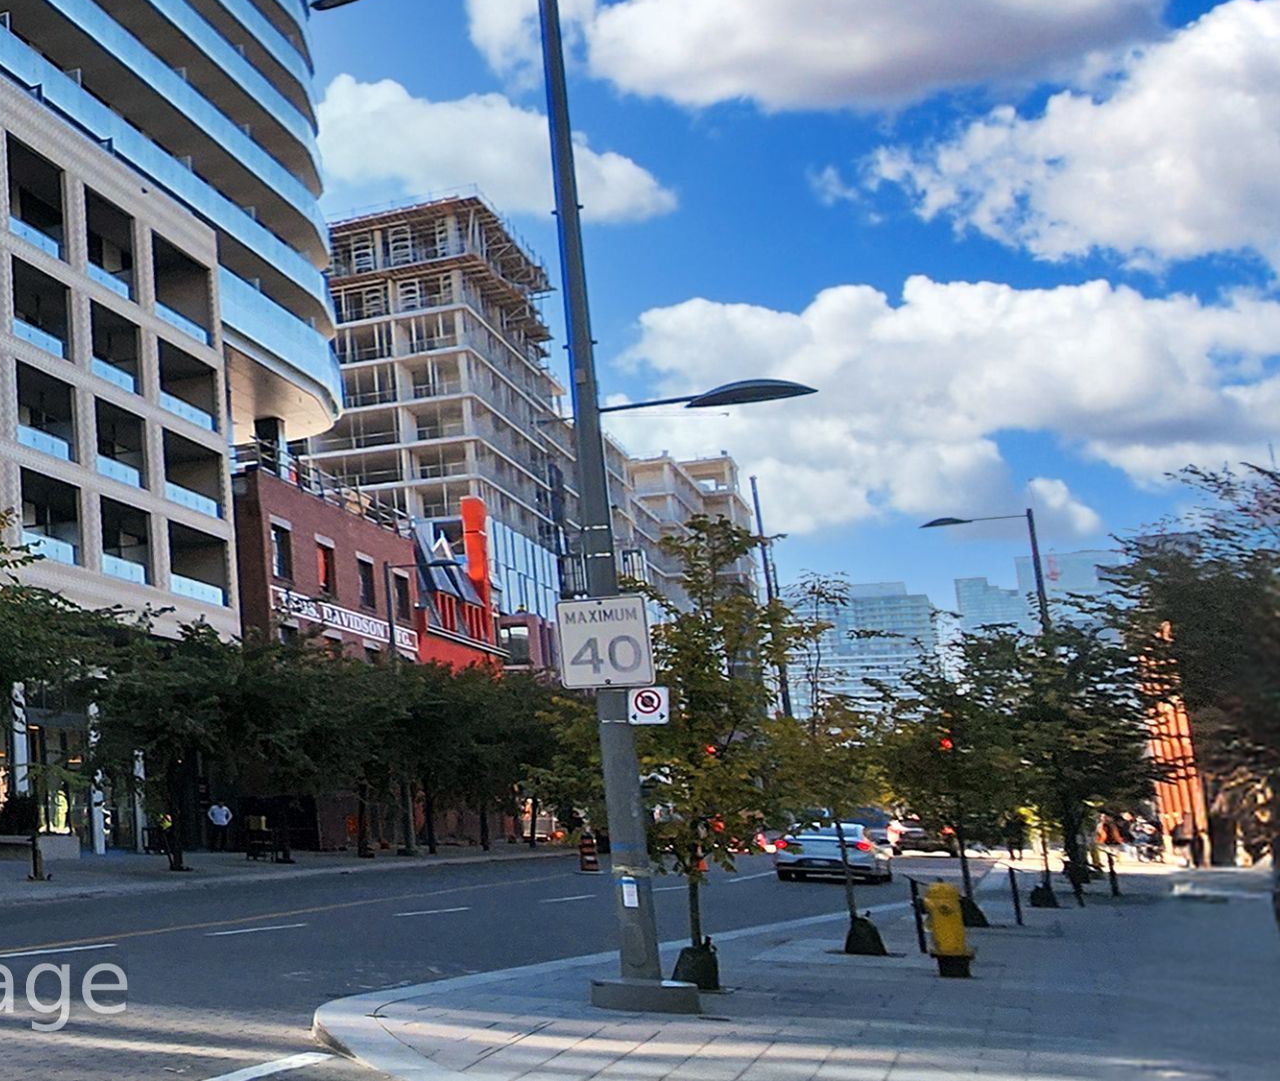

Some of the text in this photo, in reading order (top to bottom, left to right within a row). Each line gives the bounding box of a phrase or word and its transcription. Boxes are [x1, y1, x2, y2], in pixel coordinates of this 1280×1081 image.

[322, 607, 384, 638] DAVIDSON
[386, 625, 412, 645] FG.
[564, 607, 637, 625] MAXIMUM
[571, 635, 642, 674] 40
